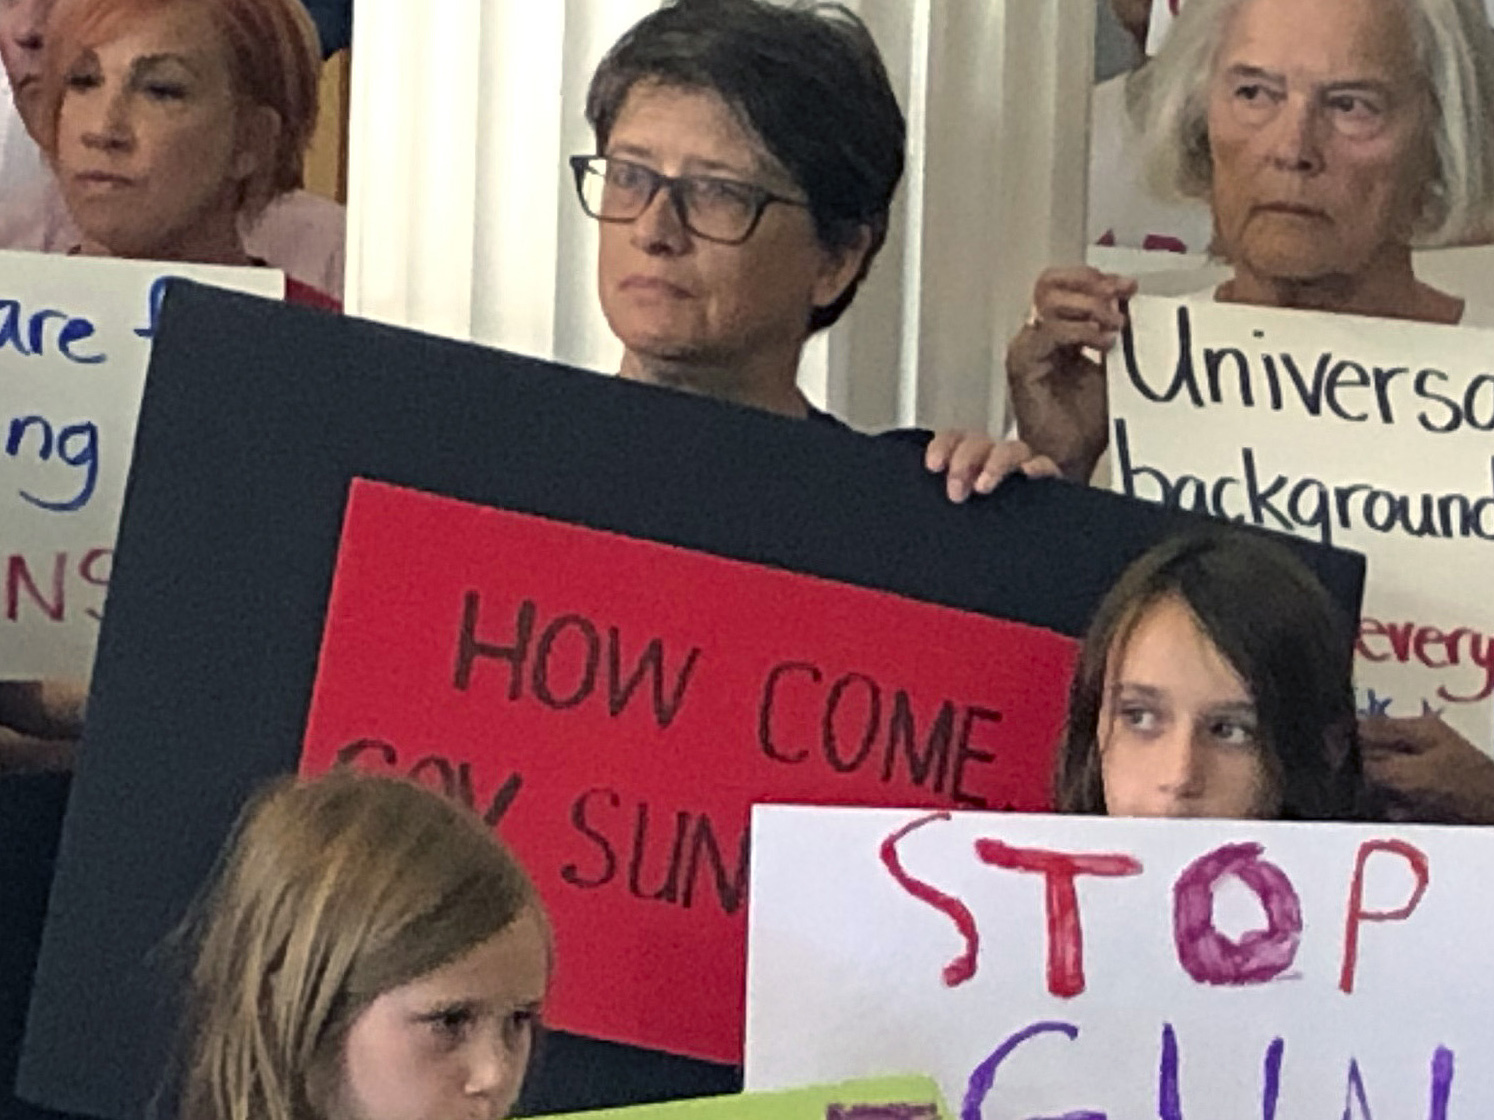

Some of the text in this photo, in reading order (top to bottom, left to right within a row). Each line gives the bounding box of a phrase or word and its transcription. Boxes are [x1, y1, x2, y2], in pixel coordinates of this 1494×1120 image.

[453, 590, 1002, 806] HOW COME
[878, 811, 1431, 999] STOP
